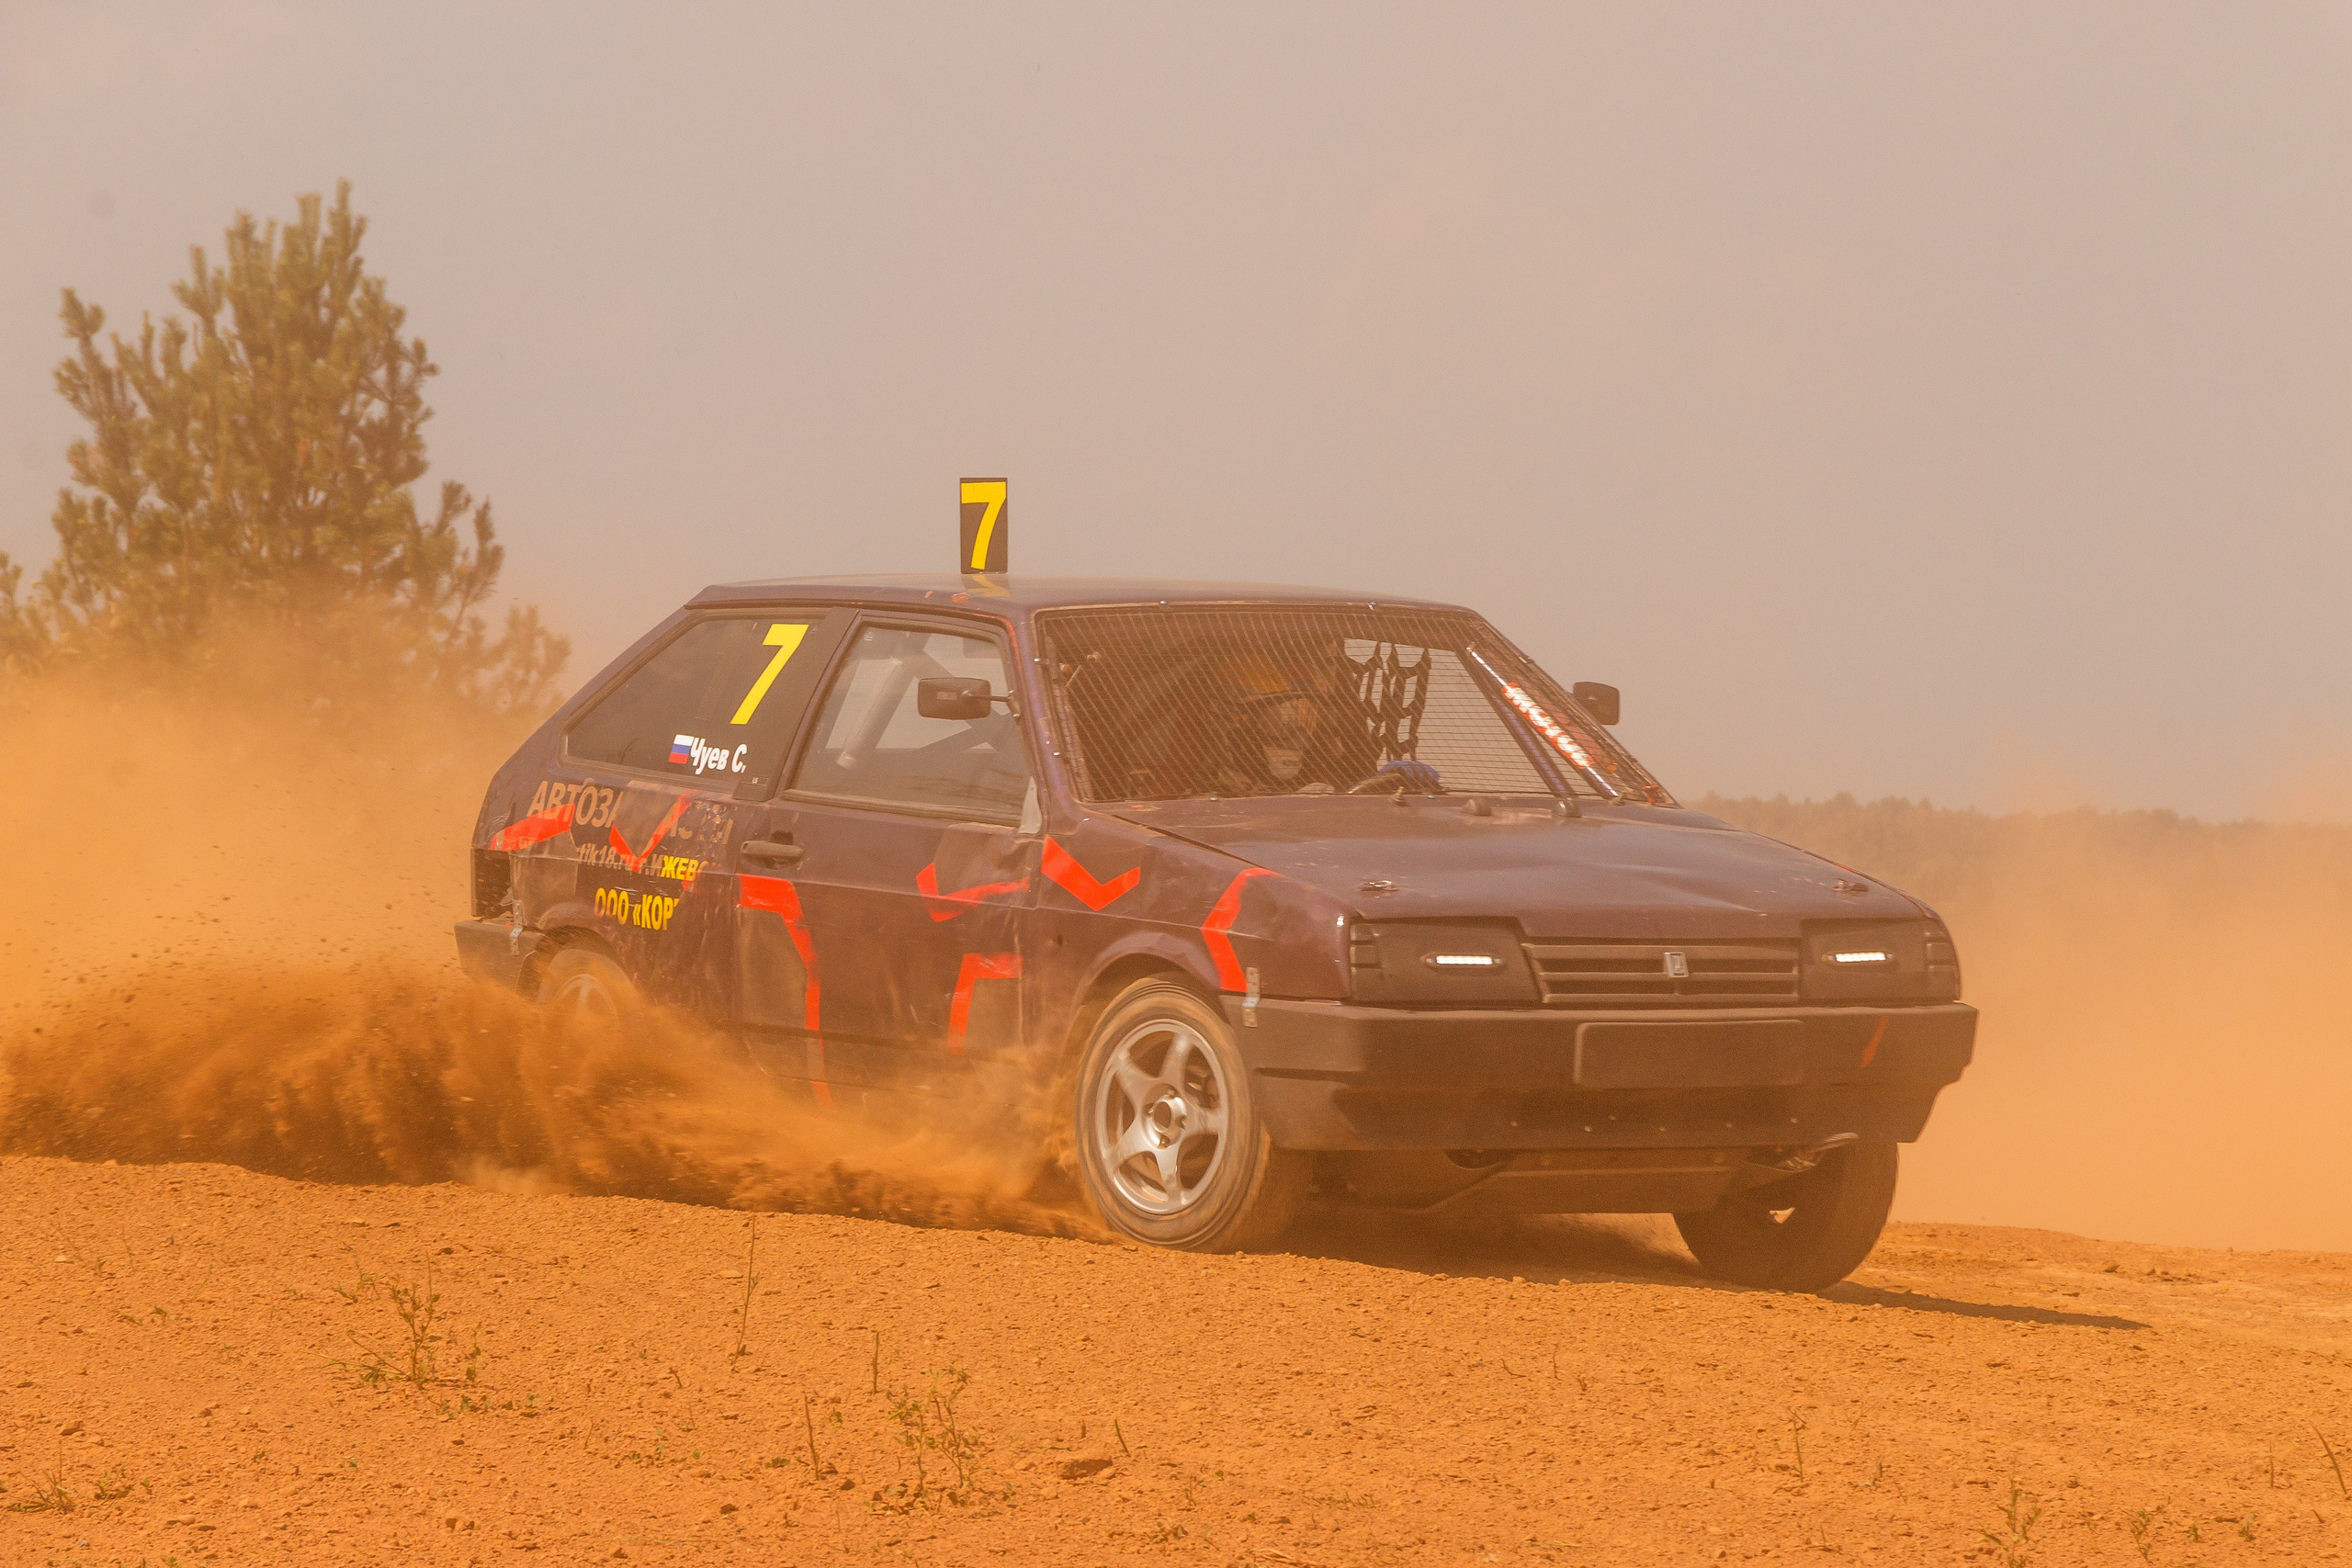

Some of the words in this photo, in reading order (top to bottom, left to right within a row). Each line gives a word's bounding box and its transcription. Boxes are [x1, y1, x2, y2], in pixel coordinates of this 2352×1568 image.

[961, 481, 1007, 570] 7
[730, 624, 809, 725] 7
[690, 737, 730, 774] Чуев
[594, 887, 629, 925] ООО
